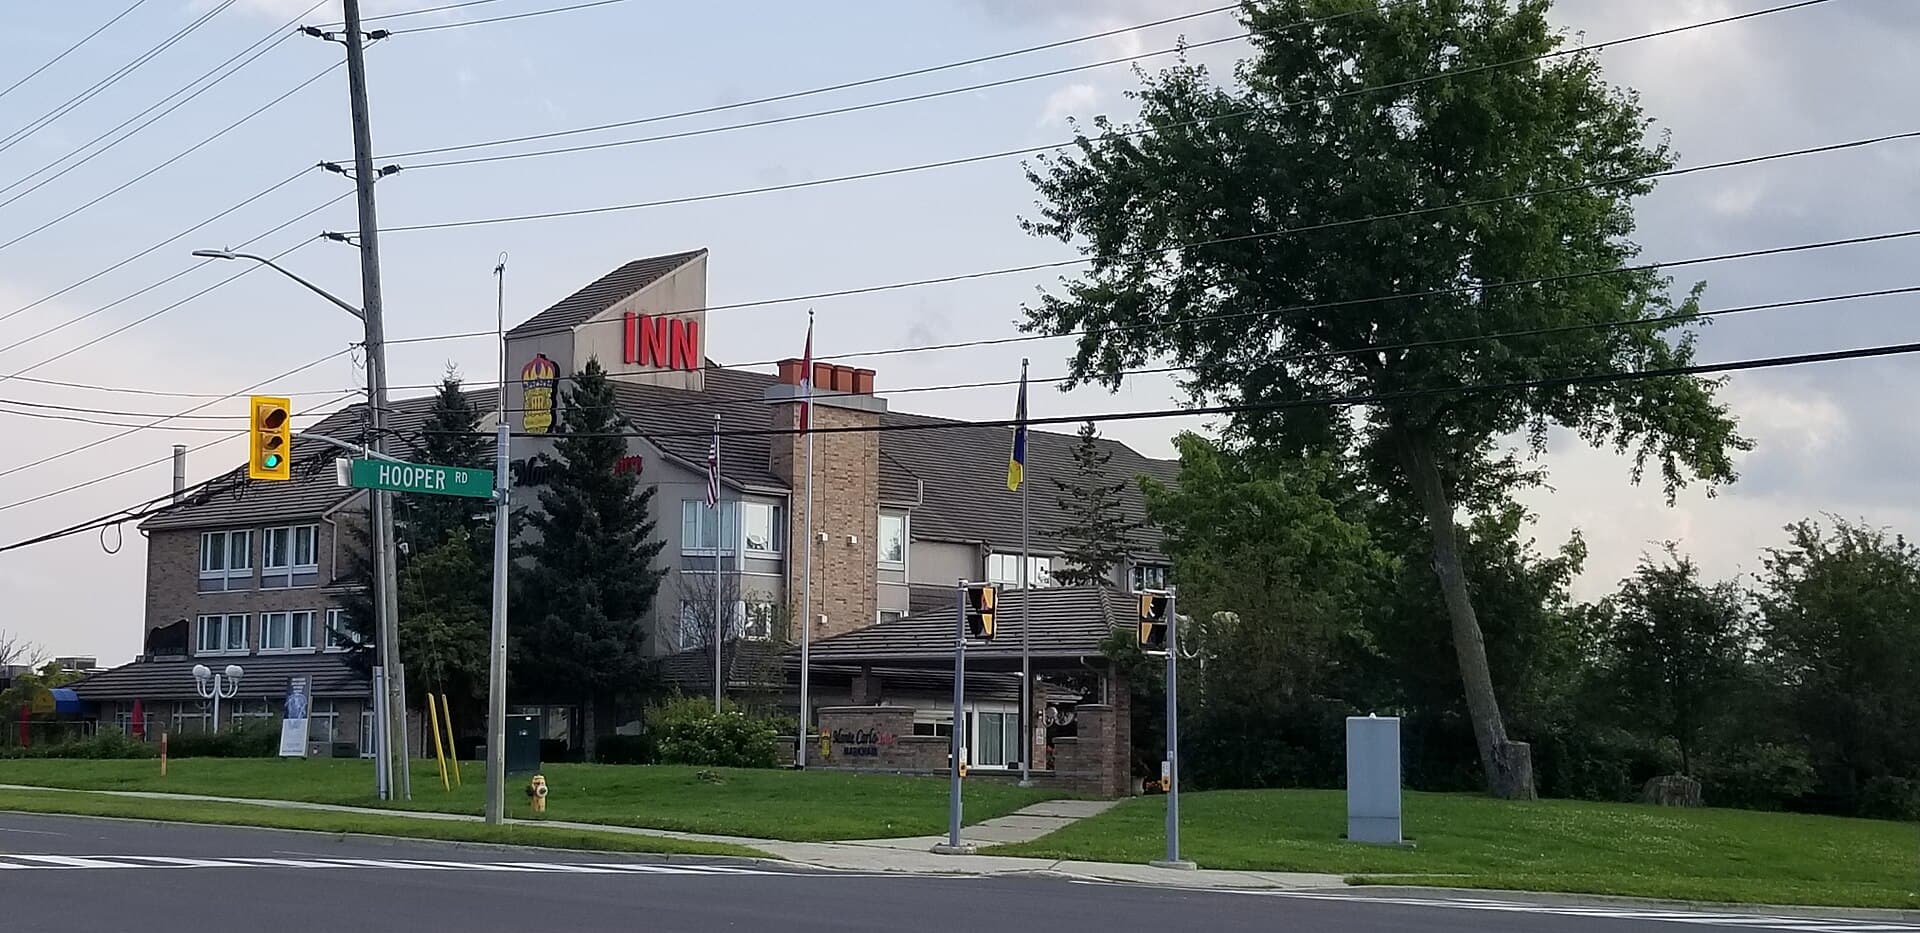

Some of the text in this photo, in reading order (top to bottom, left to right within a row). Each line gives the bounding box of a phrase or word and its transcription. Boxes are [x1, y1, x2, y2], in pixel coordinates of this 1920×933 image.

[624, 311, 698, 372] INN
[379, 464, 468, 490] HOOPER RD
